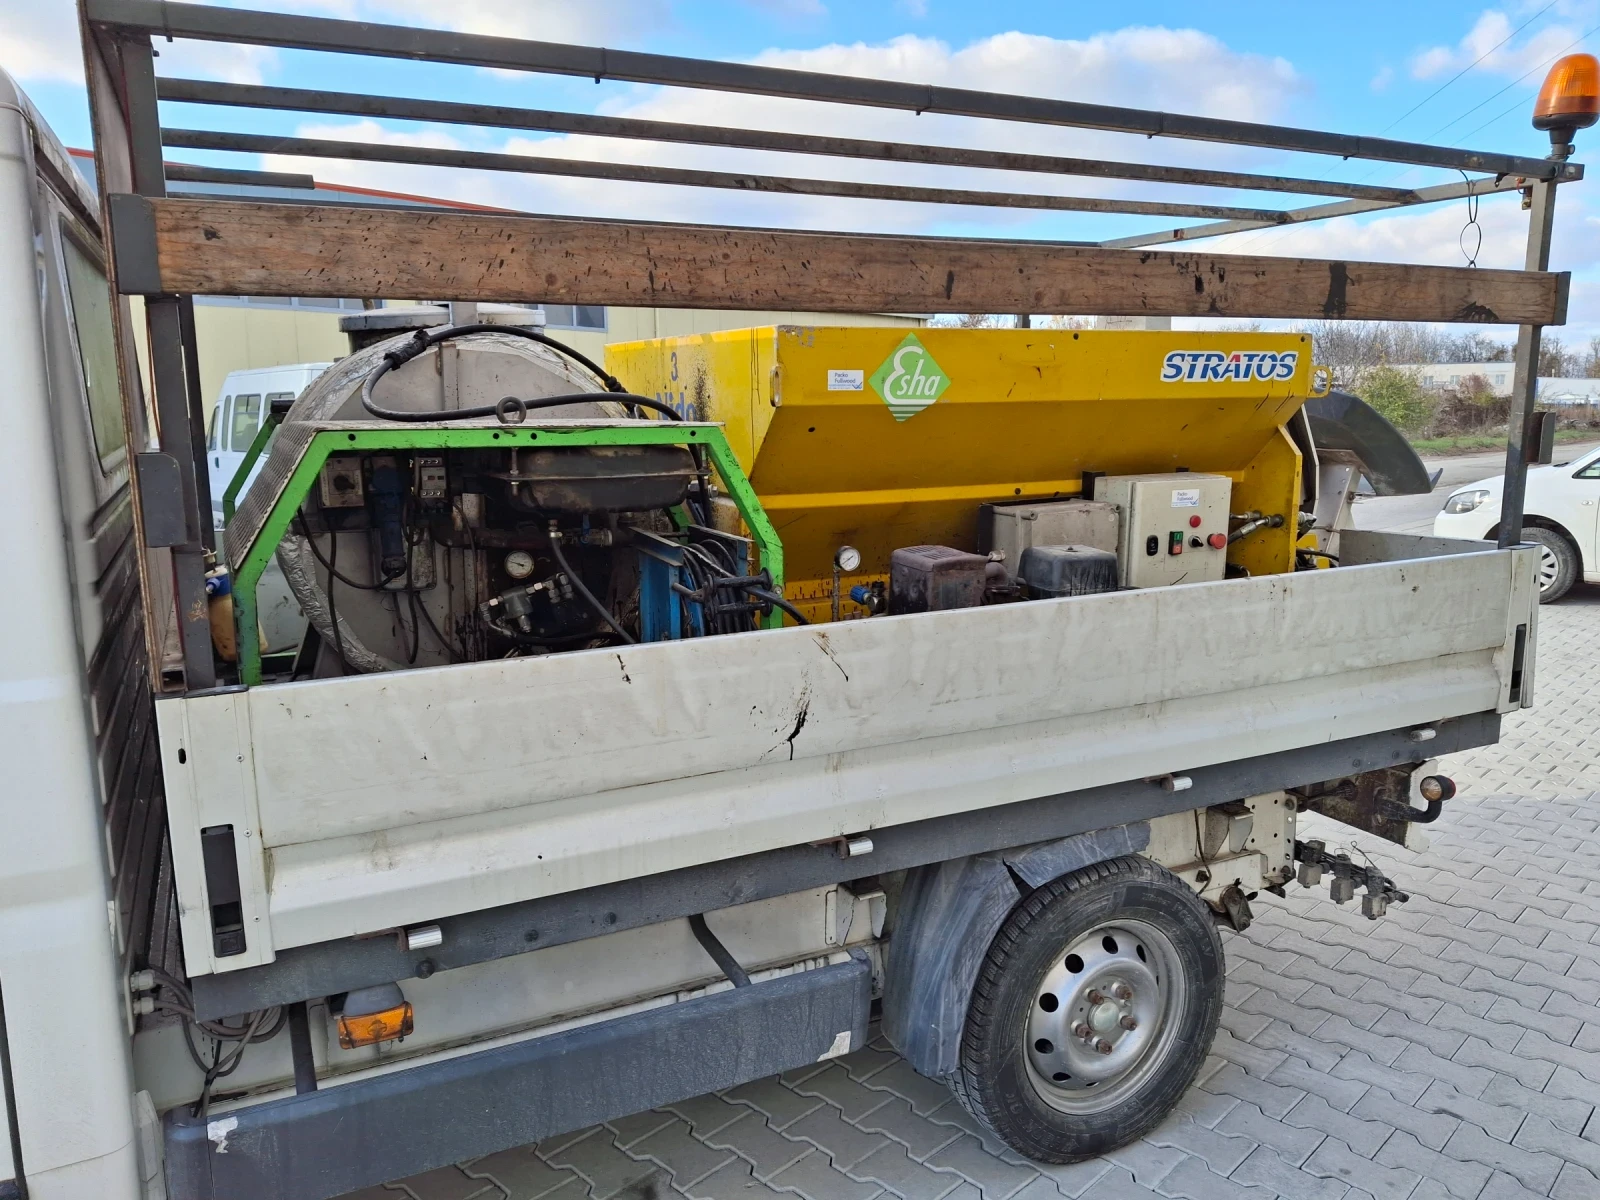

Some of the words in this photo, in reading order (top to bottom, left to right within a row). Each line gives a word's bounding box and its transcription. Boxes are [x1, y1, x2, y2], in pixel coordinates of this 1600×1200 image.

[670, 351, 679, 382] 3
[883, 345, 942, 405] Esha
[1162, 352, 1298, 380] STRATOS
